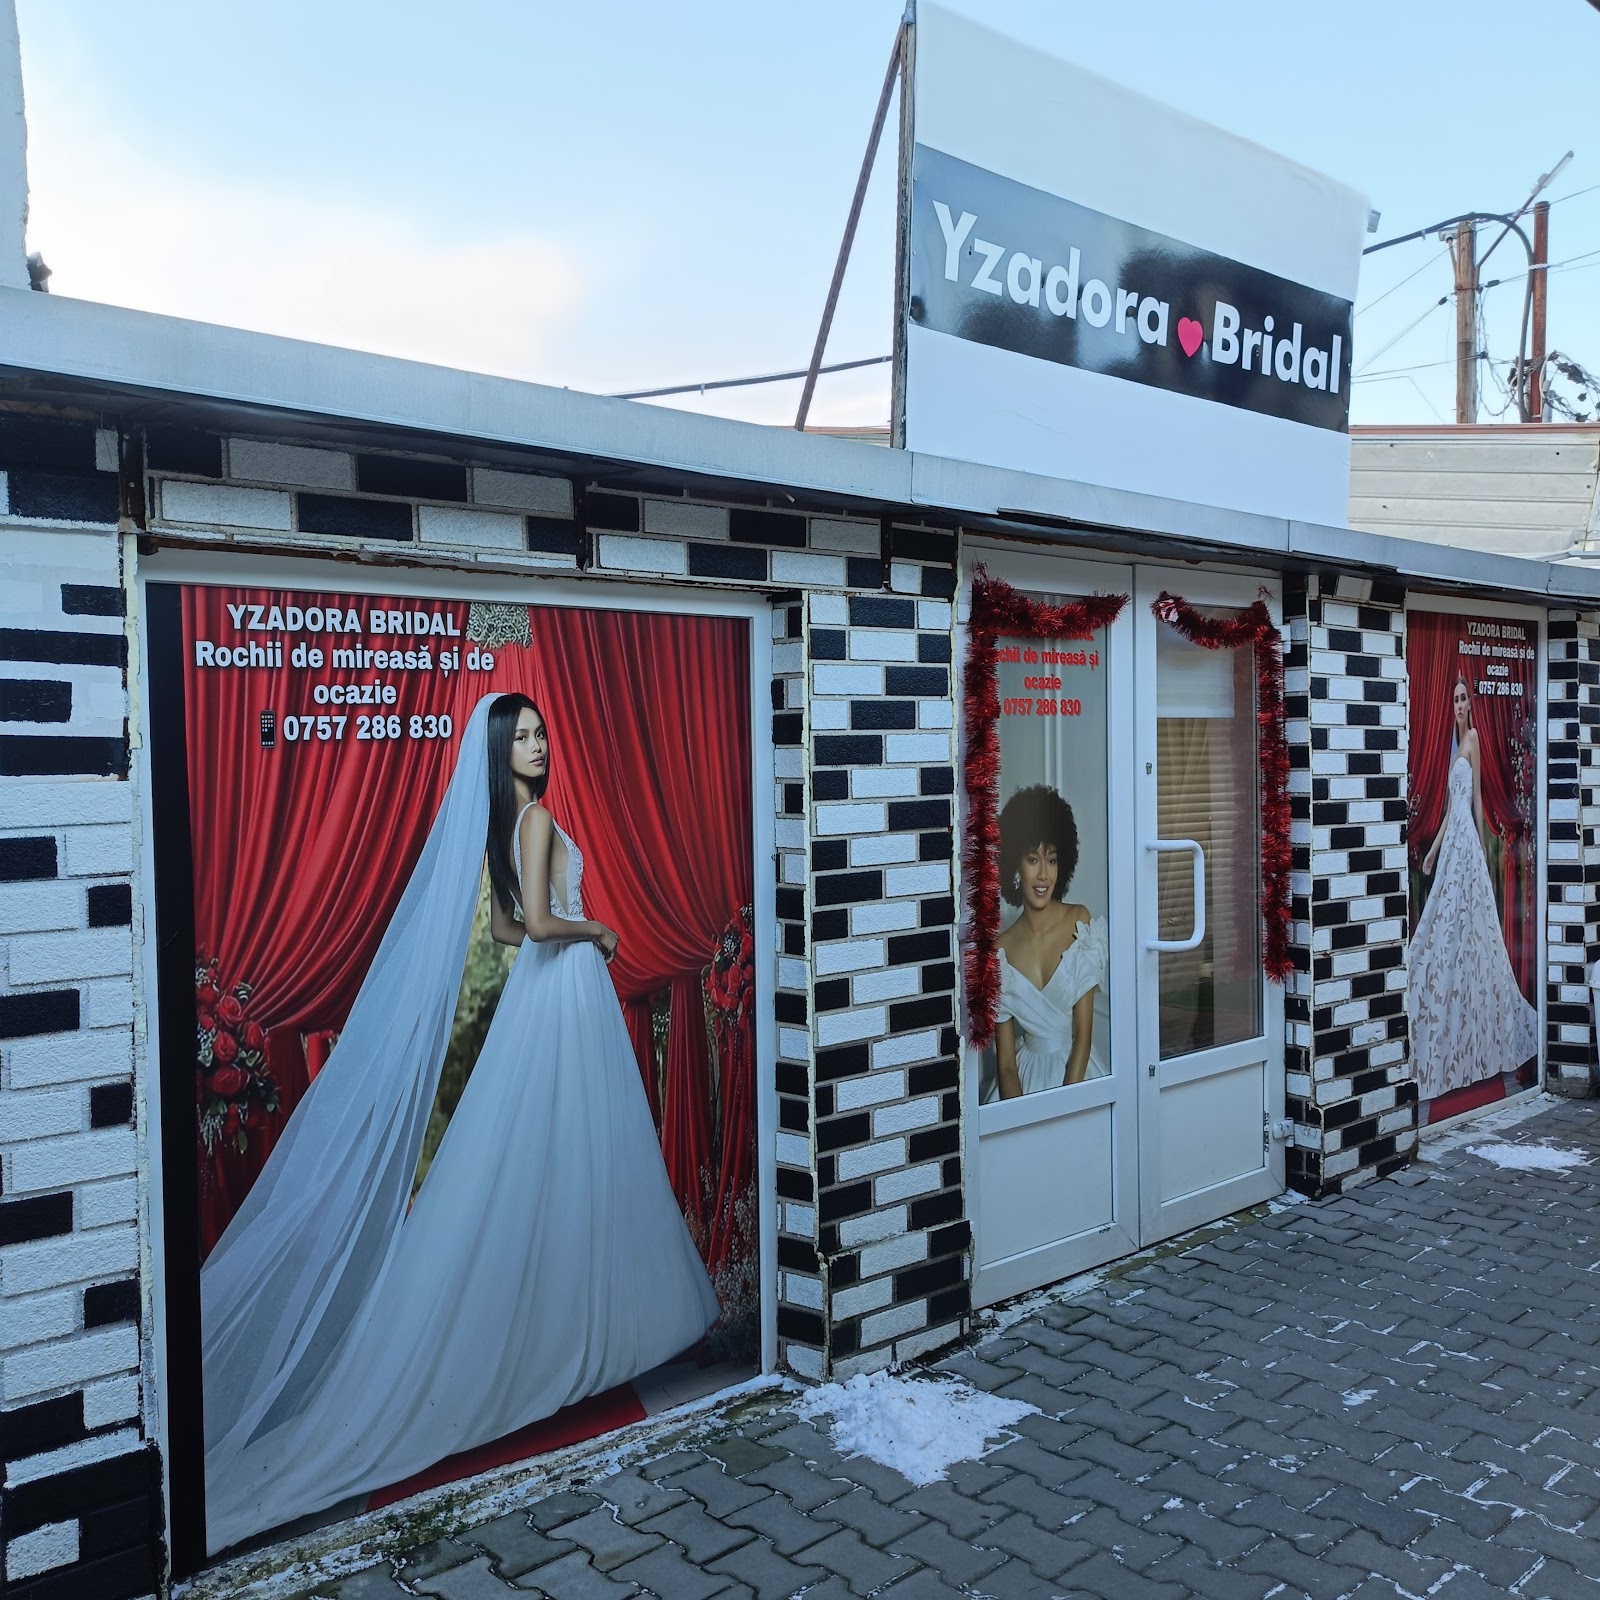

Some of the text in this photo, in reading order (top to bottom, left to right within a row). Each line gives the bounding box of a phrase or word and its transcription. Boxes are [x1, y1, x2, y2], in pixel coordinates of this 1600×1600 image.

[933, 200, 1342, 394] Yzadora Bridal
[226, 603, 461, 636] YZADORA BRIDAL
[1467, 621, 1527, 641] YZADORA BRIDAL
[195, 640, 495, 678] Rochii de mireasă și de
[993, 646, 1099, 671] chii de mireasă și
[1459, 640, 1535, 663] Rochii de mireasă și de
[1024, 673, 1062, 690] ocazie
[1487, 663, 1509, 677] ocazie
[313, 679, 397, 705] ocazie
[1479, 680, 1523, 696] 0757 286 830
[1003, 698, 1082, 716] 0757 286 830
[283, 714, 453, 741] 0757 286 830
